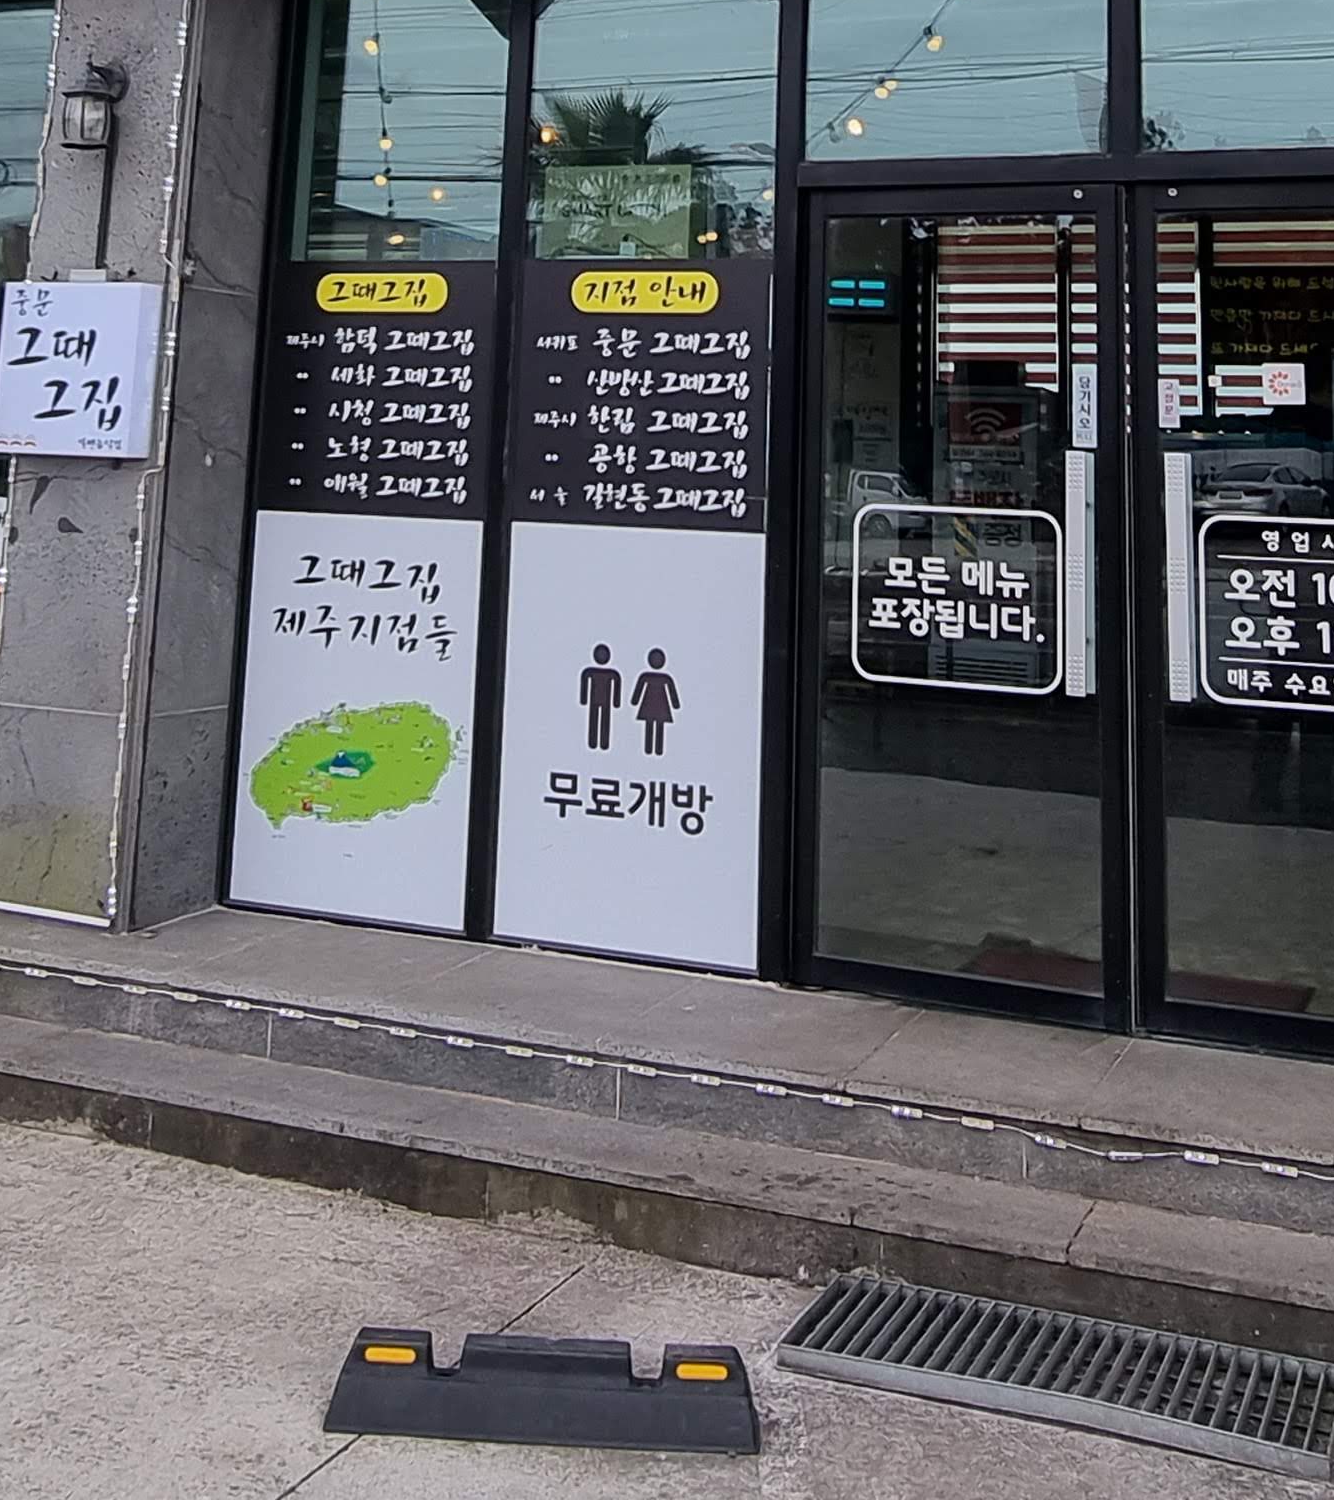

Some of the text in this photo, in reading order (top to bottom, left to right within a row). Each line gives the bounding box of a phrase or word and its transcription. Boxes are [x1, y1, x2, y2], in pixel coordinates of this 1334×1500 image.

[11, 288, 53, 317] 중문
[326, 278, 427, 307] 그때그집
[584, 275, 706, 308] 지점 안내
[7, 327, 97, 367] 그때
[333, 326, 377, 355] 함덕
[383, 329, 474, 356] 그때그집
[535, 328, 751, 360] 서귀포 중문 그때그집
[331, 363, 472, 393] 세화 그때그집
[587, 368, 750, 400] 산방산 그때그집
[33, 376, 122, 431] 그집
[327, 400, 471, 429] 시청 그때그집
[1078, 375, 1092, 430] 당기시오
[587, 404, 636, 436] 한림
[646, 409, 749, 440] 그때그집
[325, 435, 469, 467] 노형 그때그집
[587, 442, 748, 479] 공항 그때그집
[323, 472, 467, 504] 애월 그때그집
[583, 482, 651, 513] 갈현동
[653, 487, 747, 518] 그때그집
[292, 554, 442, 604] 그때그집
[883, 556, 1030, 600] 모든 메뉴
[1223, 567, 1297, 610] 오전
[272, 604, 458, 662] 제주지점들
[868, 596, 1046, 644] 포장됩니다.
[1223, 614, 1301, 656] 오후
[1226, 668, 1273, 693] 매주
[543, 771, 714, 836] 무료개방
